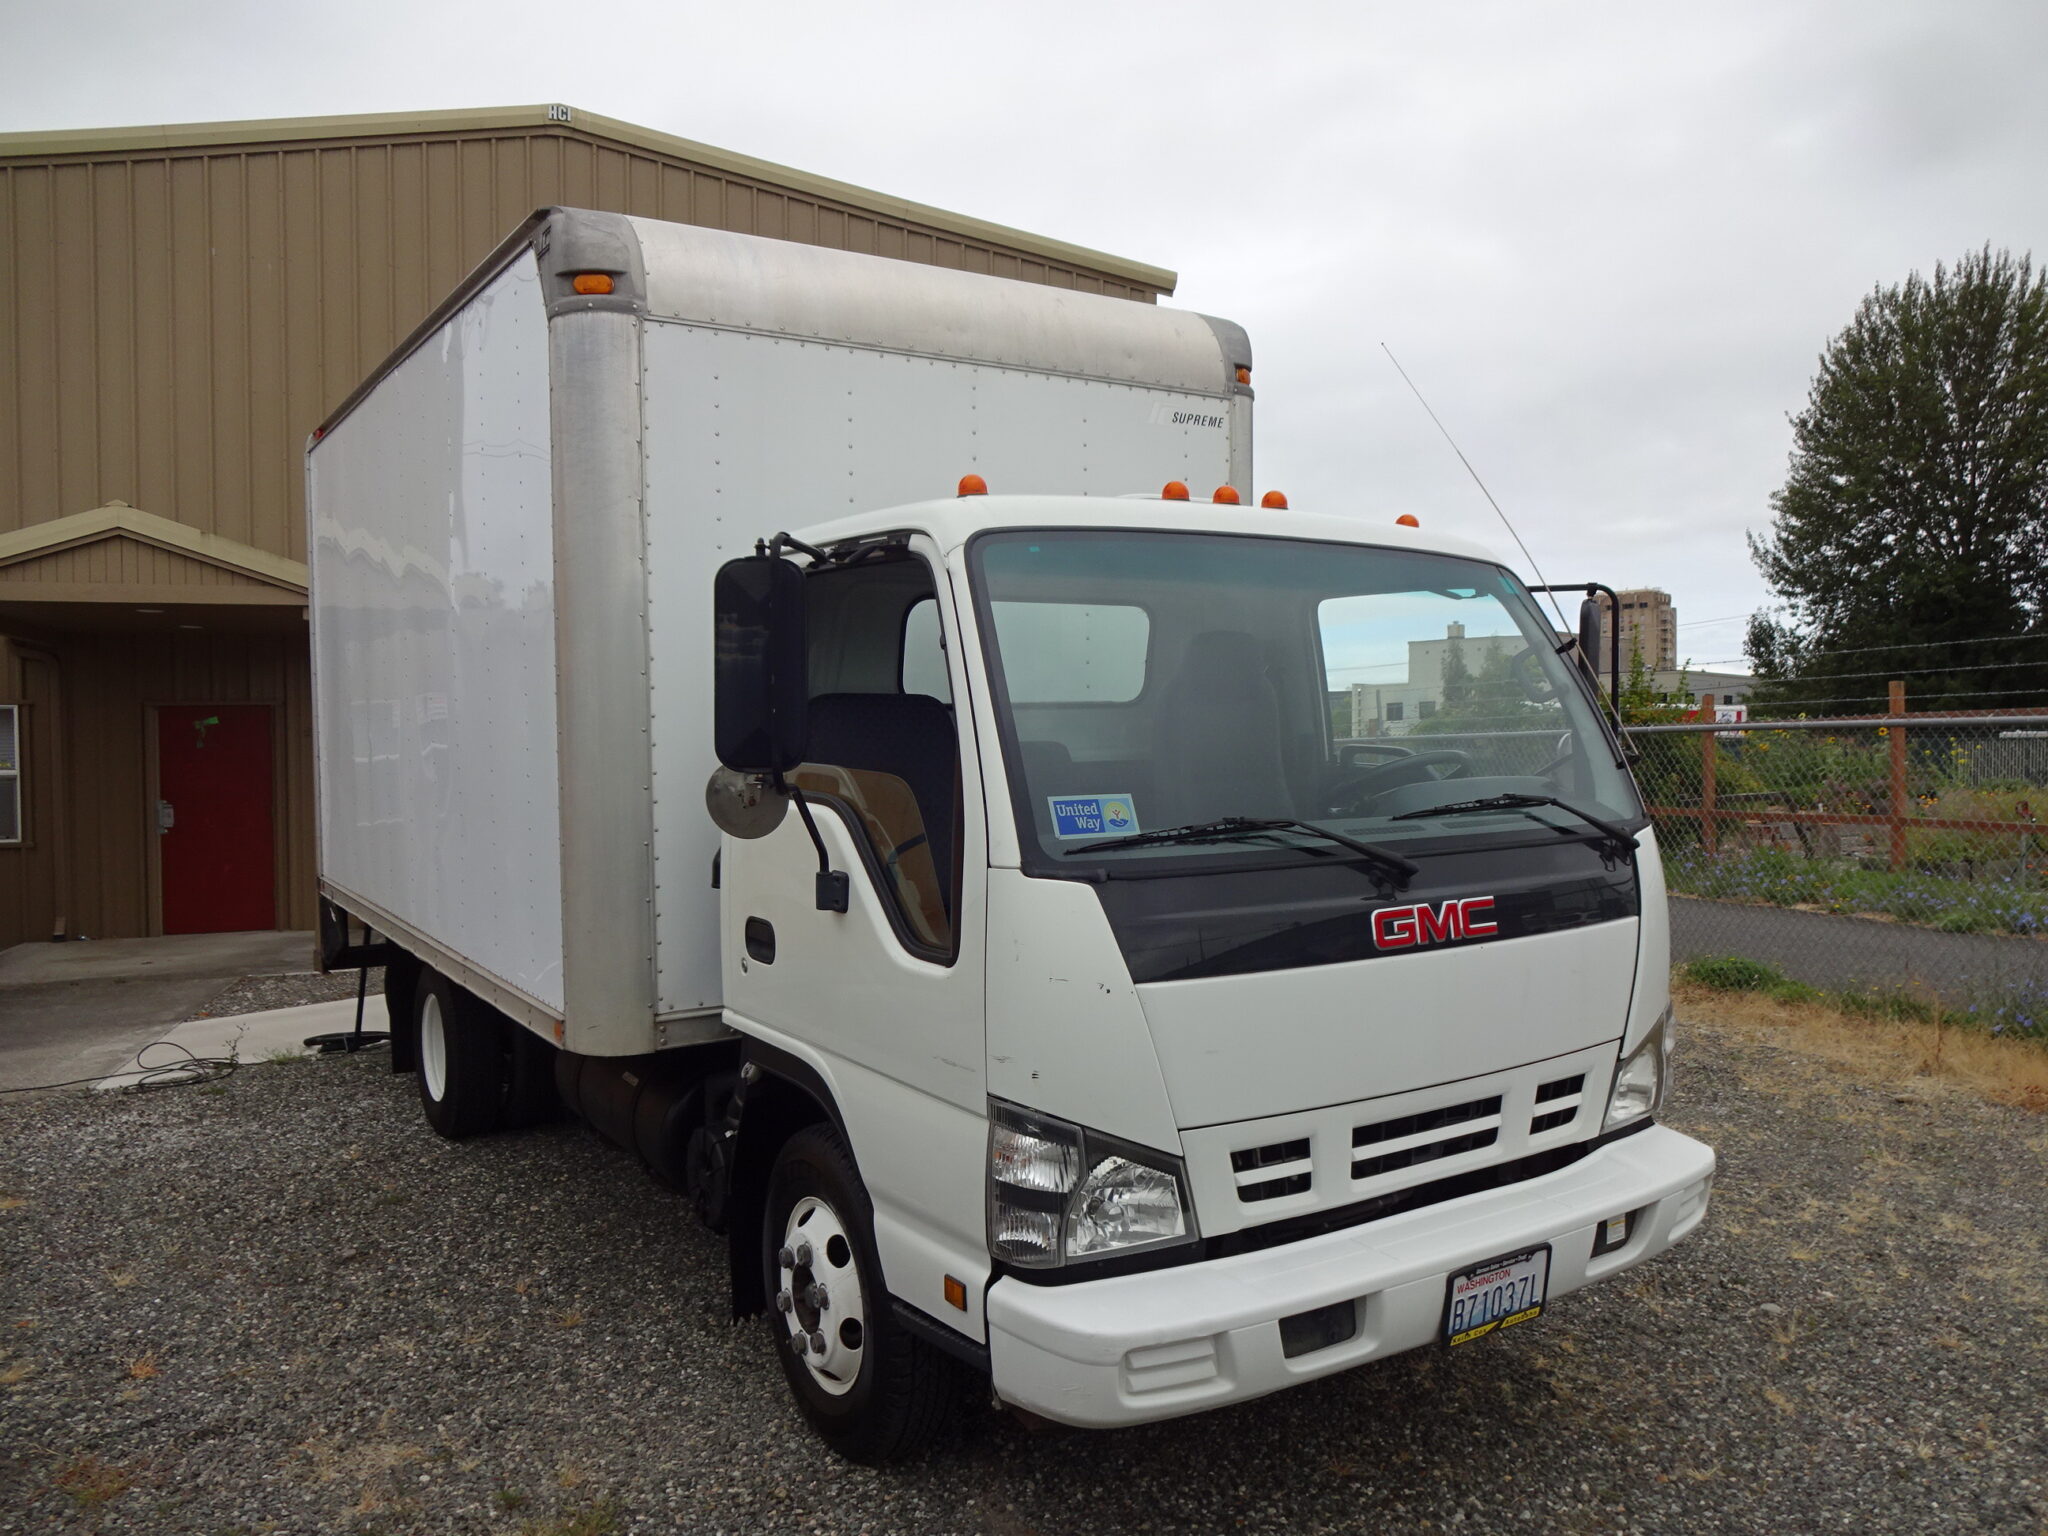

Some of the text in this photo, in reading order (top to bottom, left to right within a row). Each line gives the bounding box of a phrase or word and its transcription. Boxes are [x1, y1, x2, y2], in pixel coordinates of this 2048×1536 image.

[548, 104, 572, 121] HCI
[1172, 411, 1224, 429] SUPREME
[1056, 803, 1099, 817] United
[1076, 817, 1101, 832] Way
[1371, 896, 1498, 950] GMC
[1457, 1269, 1511, 1294] WASHINGTON
[1452, 1274, 1540, 1333] B71037L
